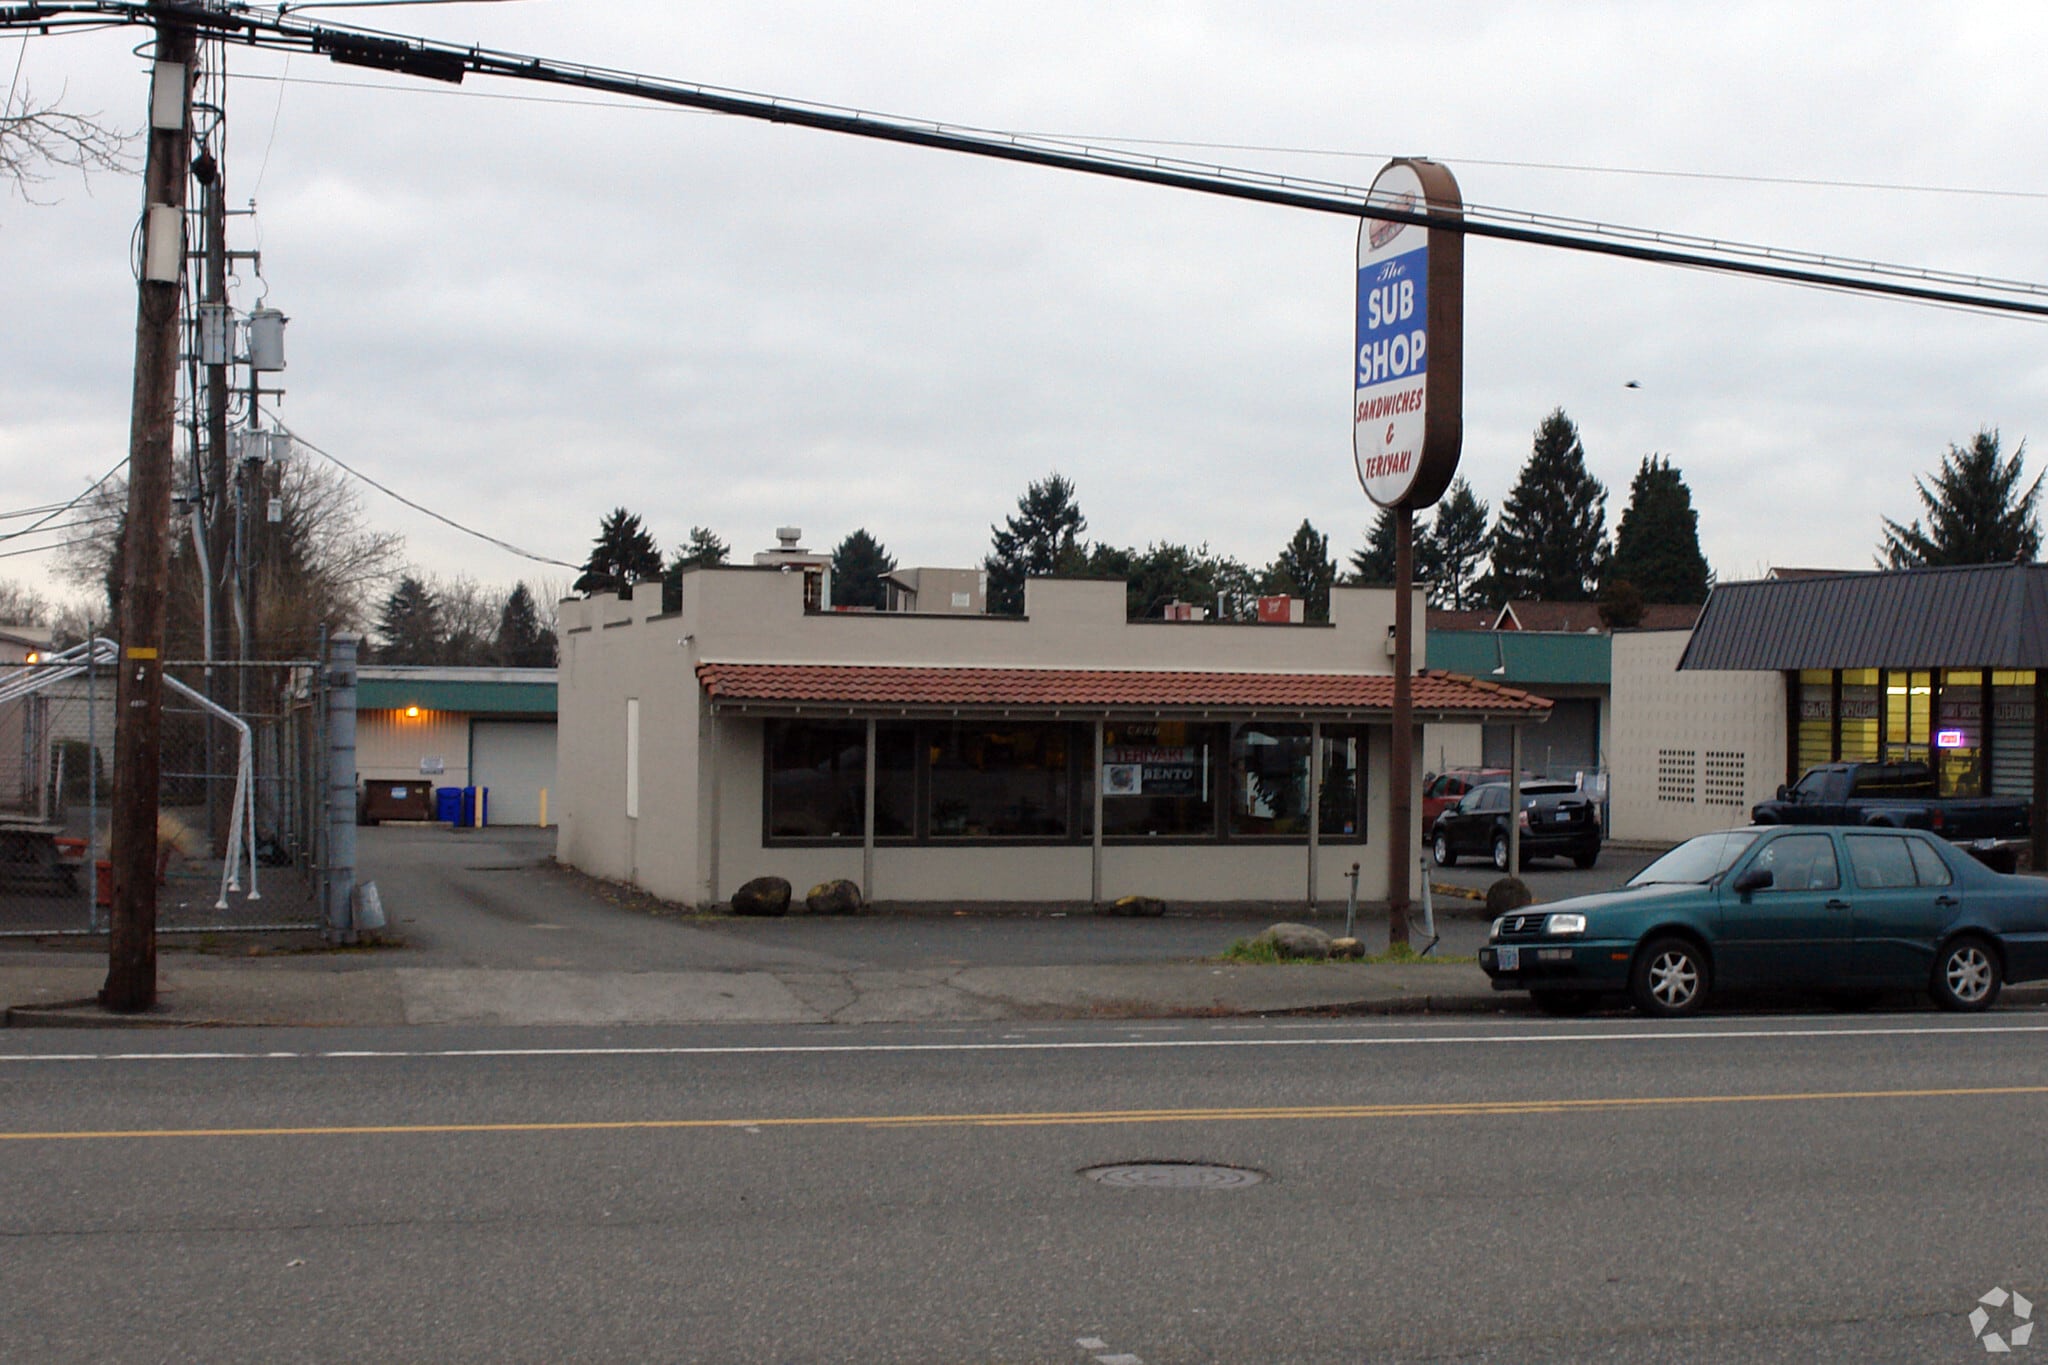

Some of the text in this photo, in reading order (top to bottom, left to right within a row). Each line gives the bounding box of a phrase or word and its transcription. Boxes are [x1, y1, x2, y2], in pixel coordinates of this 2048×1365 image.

[1377, 261, 1406, 281] The
[1368, 279, 1414, 330] SUB
[1359, 330, 1426, 384] SHOP
[1356, 388, 1423, 423] SANDWICHES
[1365, 451, 1412, 479] TERIYAKI
[1115, 748, 1184, 762] TERIYAKI
[1143, 769, 1193, 780] BENTO
